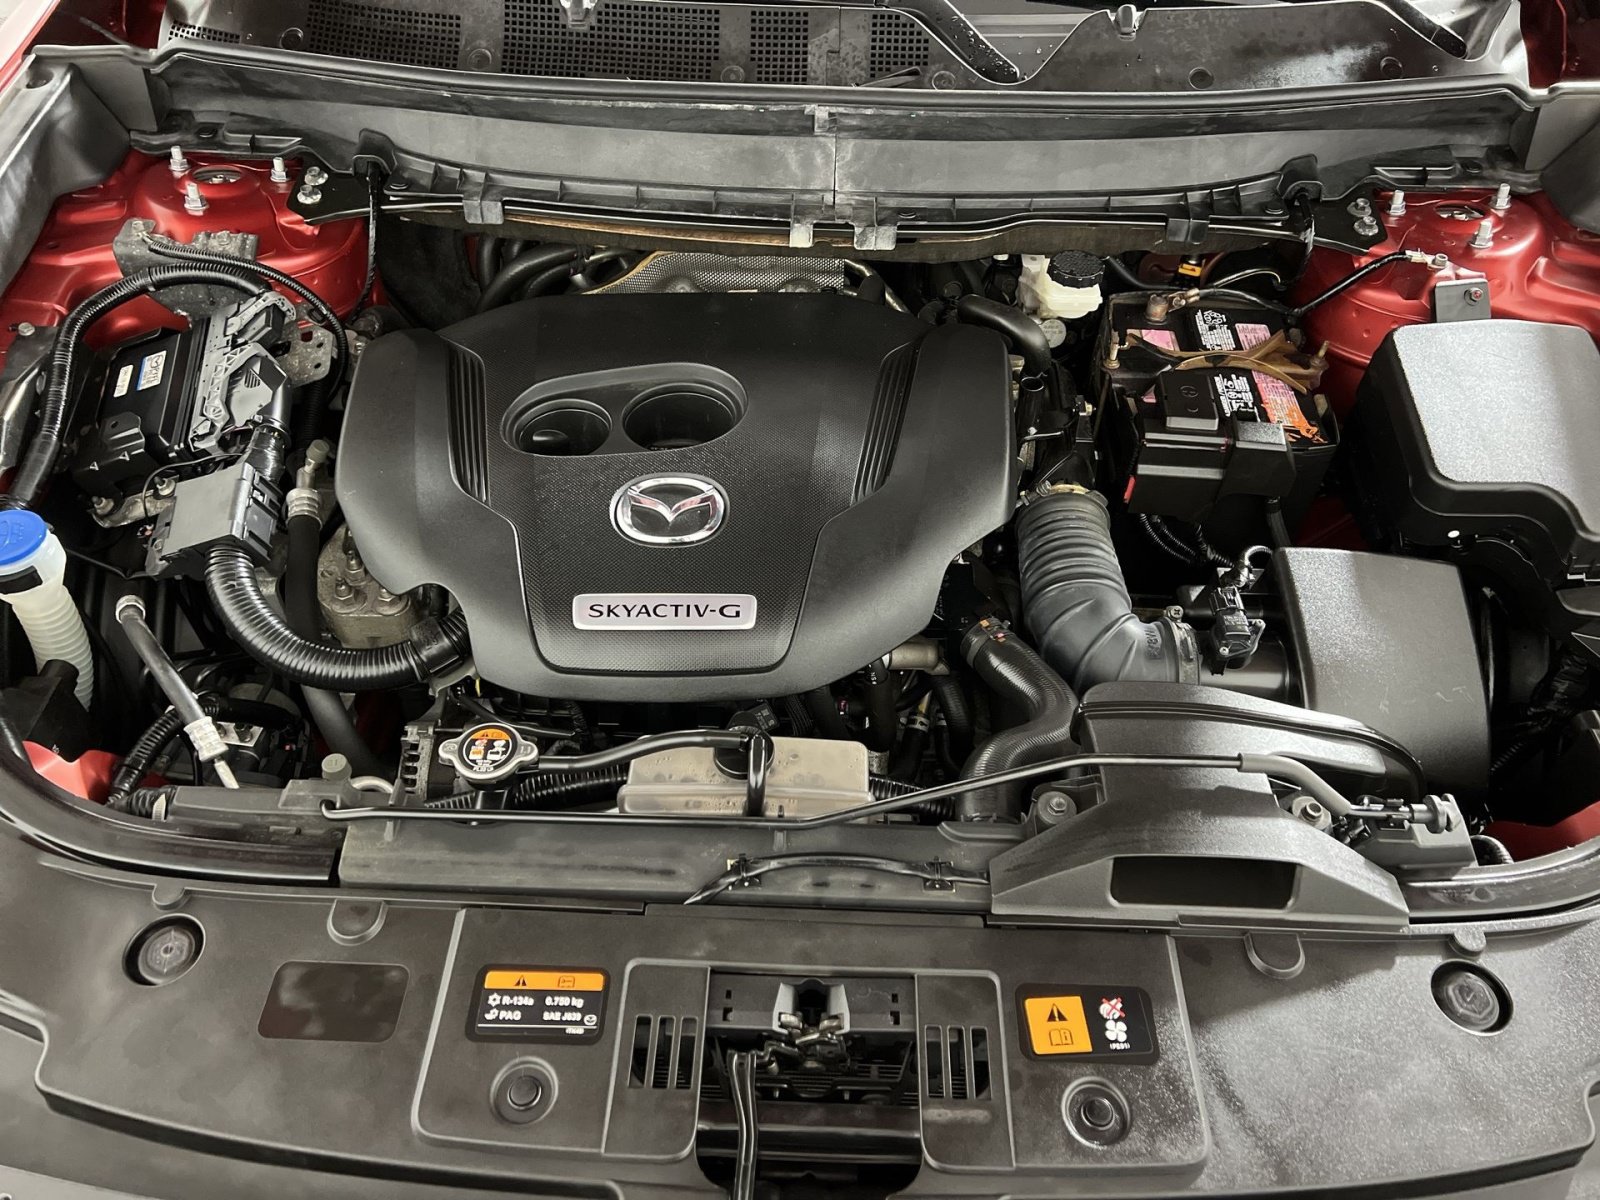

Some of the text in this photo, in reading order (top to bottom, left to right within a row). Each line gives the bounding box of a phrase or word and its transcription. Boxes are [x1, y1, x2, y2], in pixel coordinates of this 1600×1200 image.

[588, 603, 741, 618] SKYACTIV-G
[502, 995, 535, 1006] R-134a
[571, 996, 584, 1009] kg
